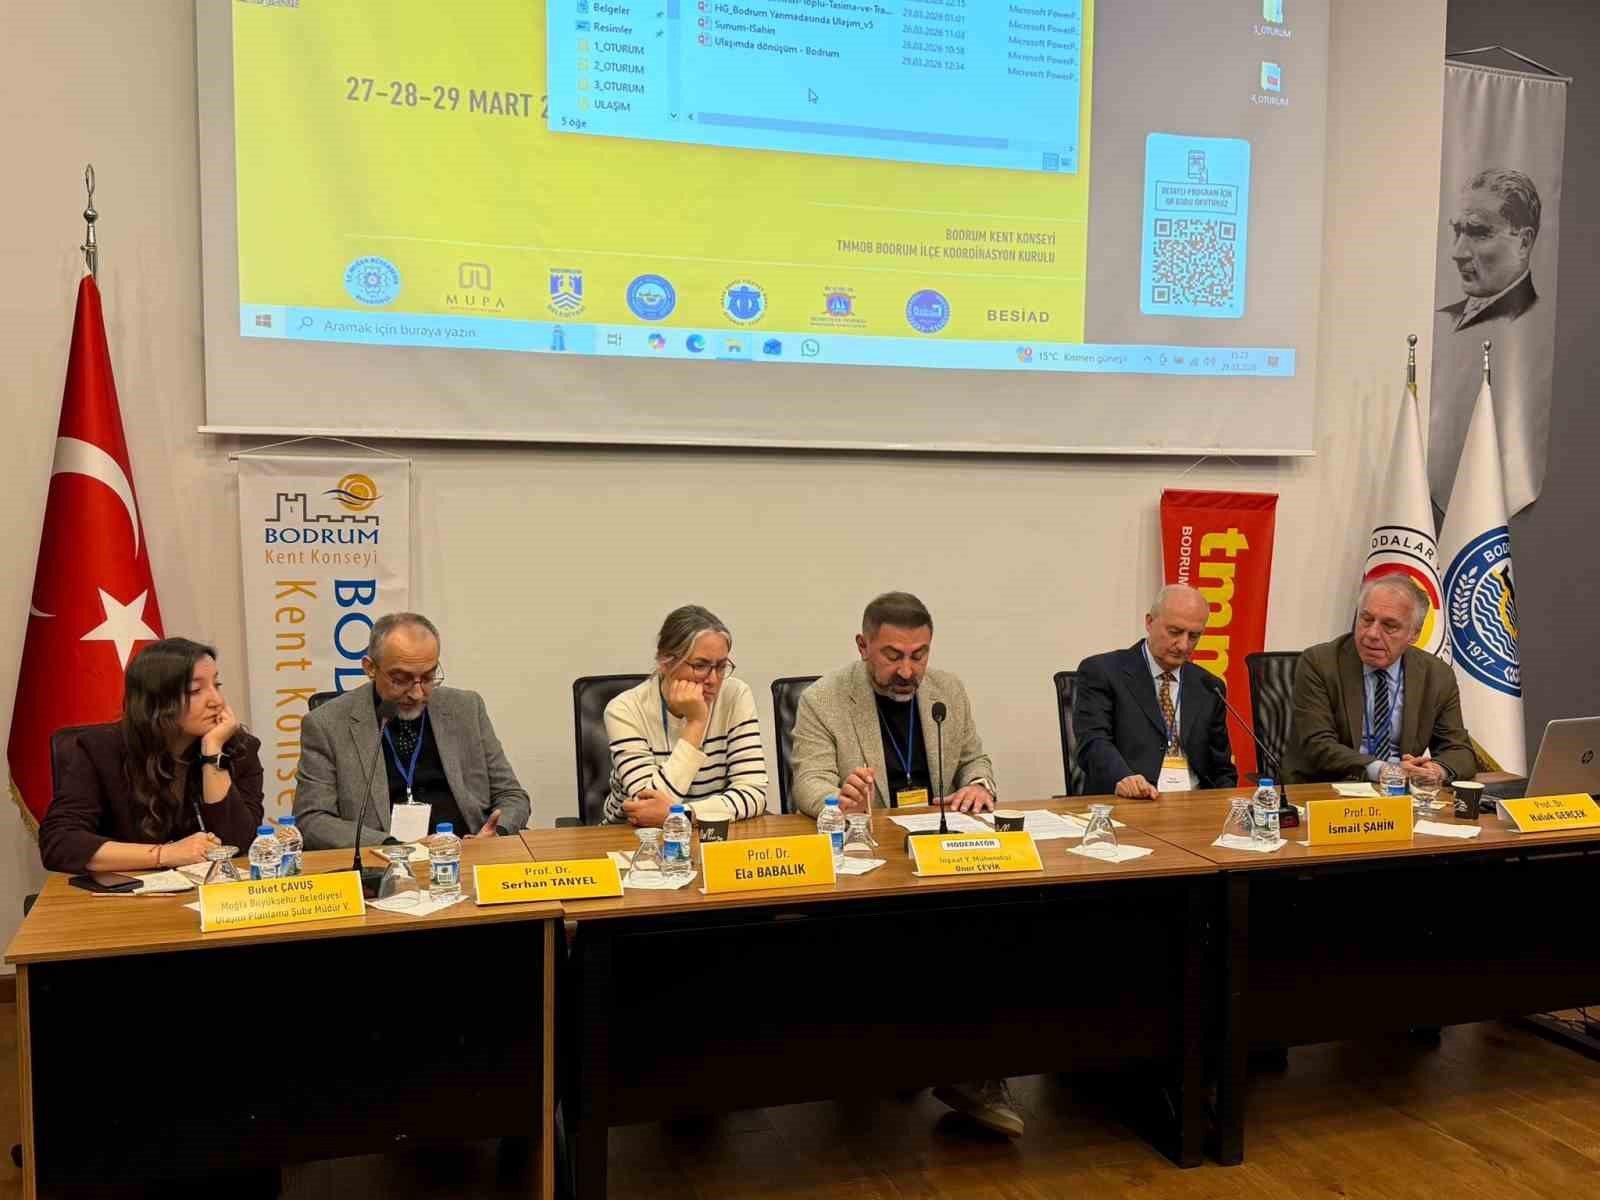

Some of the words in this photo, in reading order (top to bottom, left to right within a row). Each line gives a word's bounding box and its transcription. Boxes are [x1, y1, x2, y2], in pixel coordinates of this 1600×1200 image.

[593, 3, 631, 15] Belgeler
[715, 3, 768, 18] HG_Bodrum
[593, 22, 633, 35] Resimler
[593, 41, 645, 55] 1_OTURUM
[715, 37, 755, 50] Ulaşımda
[757, 42, 798, 55] dönüşüm
[806, 46, 841, 58] Bodrum
[593, 60, 645, 74] 2_OTURUM
[593, 80, 645, 94] 3_OTURUM
[469, 89, 533, 117] MART
[945, 228, 987, 242] BODRUM
[988, 230, 1014, 243] KENT
[1016, 231, 1057, 246] KONSEYİ
[836, 239, 874, 255] TMMOB
[875, 243, 918, 257] BODRUM
[919, 242, 942, 261] İLÇE
[943, 245, 1017, 262] KOORDİNASYON
[1017, 250, 1056, 264] KURULU
[986, 306, 1050, 323] BESİAD
[322, 319, 373, 336] Aramak
[374, 321, 399, 338] için
[400, 323, 443, 339] buraya
[444, 326, 477, 340] yazın
[264, 527, 379, 545] BODRUM
[264, 549, 306, 565] Kent
[311, 549, 378, 568] Konseyi
[275, 580, 317, 672] Kent
[1466, 640, 1496, 667] 1977
[1343, 807, 1367, 818] Prof.
[1368, 806, 1382, 817] Dr.
[1328, 822, 1360, 835] İsmail
[1363, 818, 1395, 835] ŞAHİN
[946, 839, 996, 849] MODERATÖR
[747, 848, 773, 862] Prof.
[775, 847, 791, 859] Dr.
[524, 866, 552, 876] Prof.
[555, 865, 570, 875] Dr.
[735, 867, 753, 880] Ela
[757, 863, 807, 878] BABALIK
[248, 883, 278, 896] Buket
[280, 880, 314, 895] ÇAVUŞ
[501, 879, 548, 890] Serhan
[550, 876, 598, 886] TANYEL
[299, 889, 344, 903] Belediyesi
[248, 909, 289, 921] Planlama
[291, 906, 313, 918] Şube
[314, 903, 342, 915] Müdür
